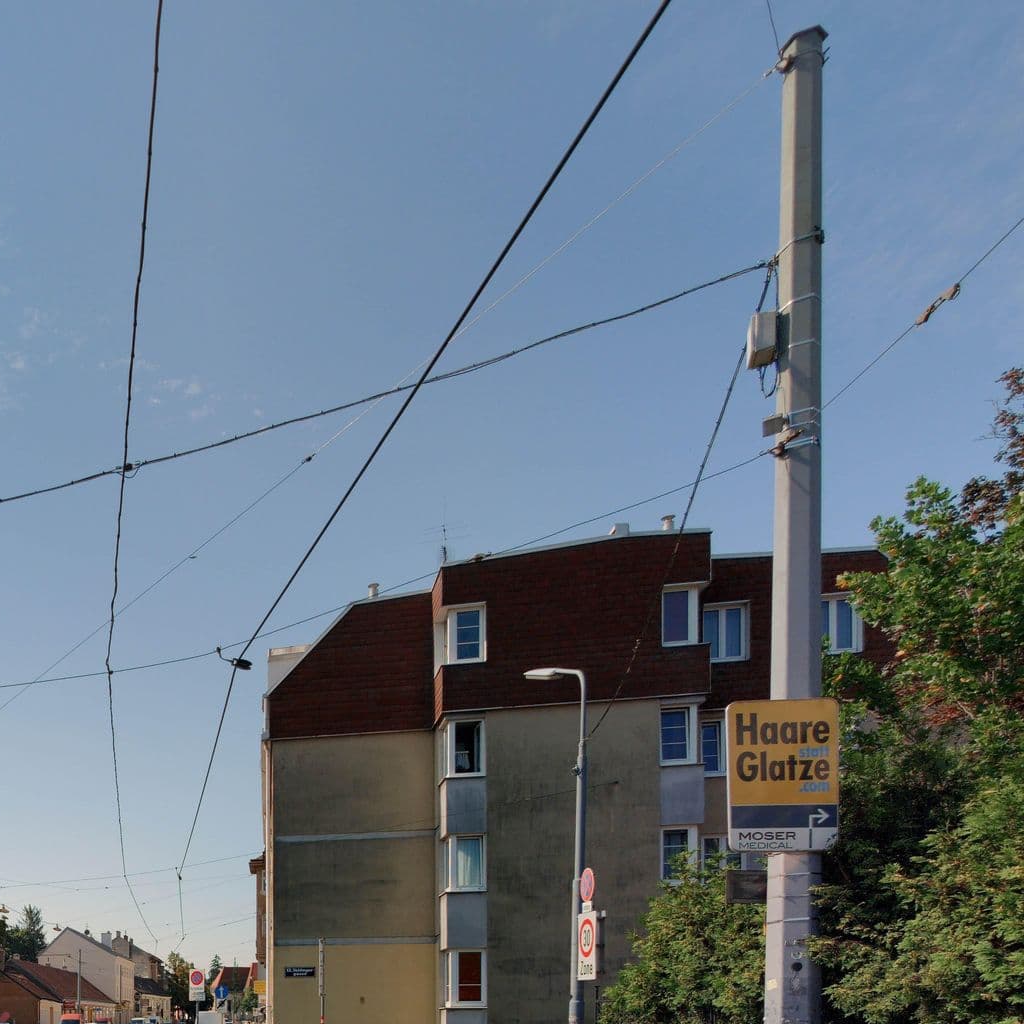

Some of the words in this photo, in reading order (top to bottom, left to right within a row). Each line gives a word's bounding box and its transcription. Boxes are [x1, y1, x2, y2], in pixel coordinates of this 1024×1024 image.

[736, 713, 830, 745] Haare
[799, 746, 829, 757] statt
[736, 751, 830, 782] Glatze
[800, 782, 829, 792] .com
[738, 831, 796, 841] MOSER
[583, 929, 590, 947] 30
